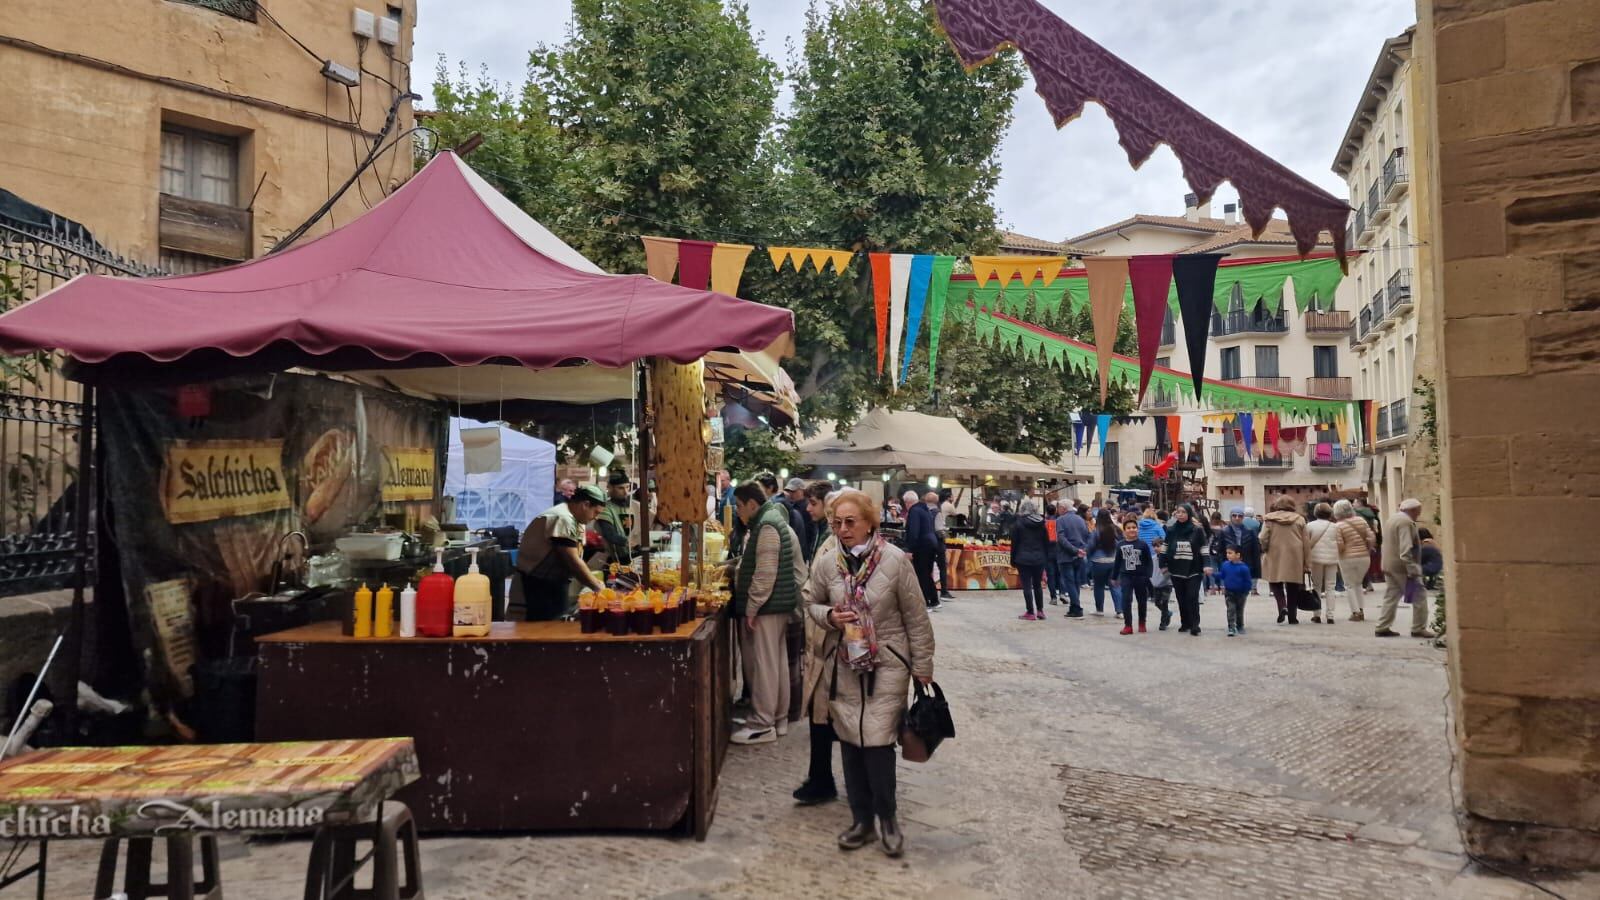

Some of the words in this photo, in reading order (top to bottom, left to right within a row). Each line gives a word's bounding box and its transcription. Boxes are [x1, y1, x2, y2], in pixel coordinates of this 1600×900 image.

[176, 453, 281, 500] Salchicha
[0, 804, 112, 838] chicha
[137, 800, 325, 835] Alemana
